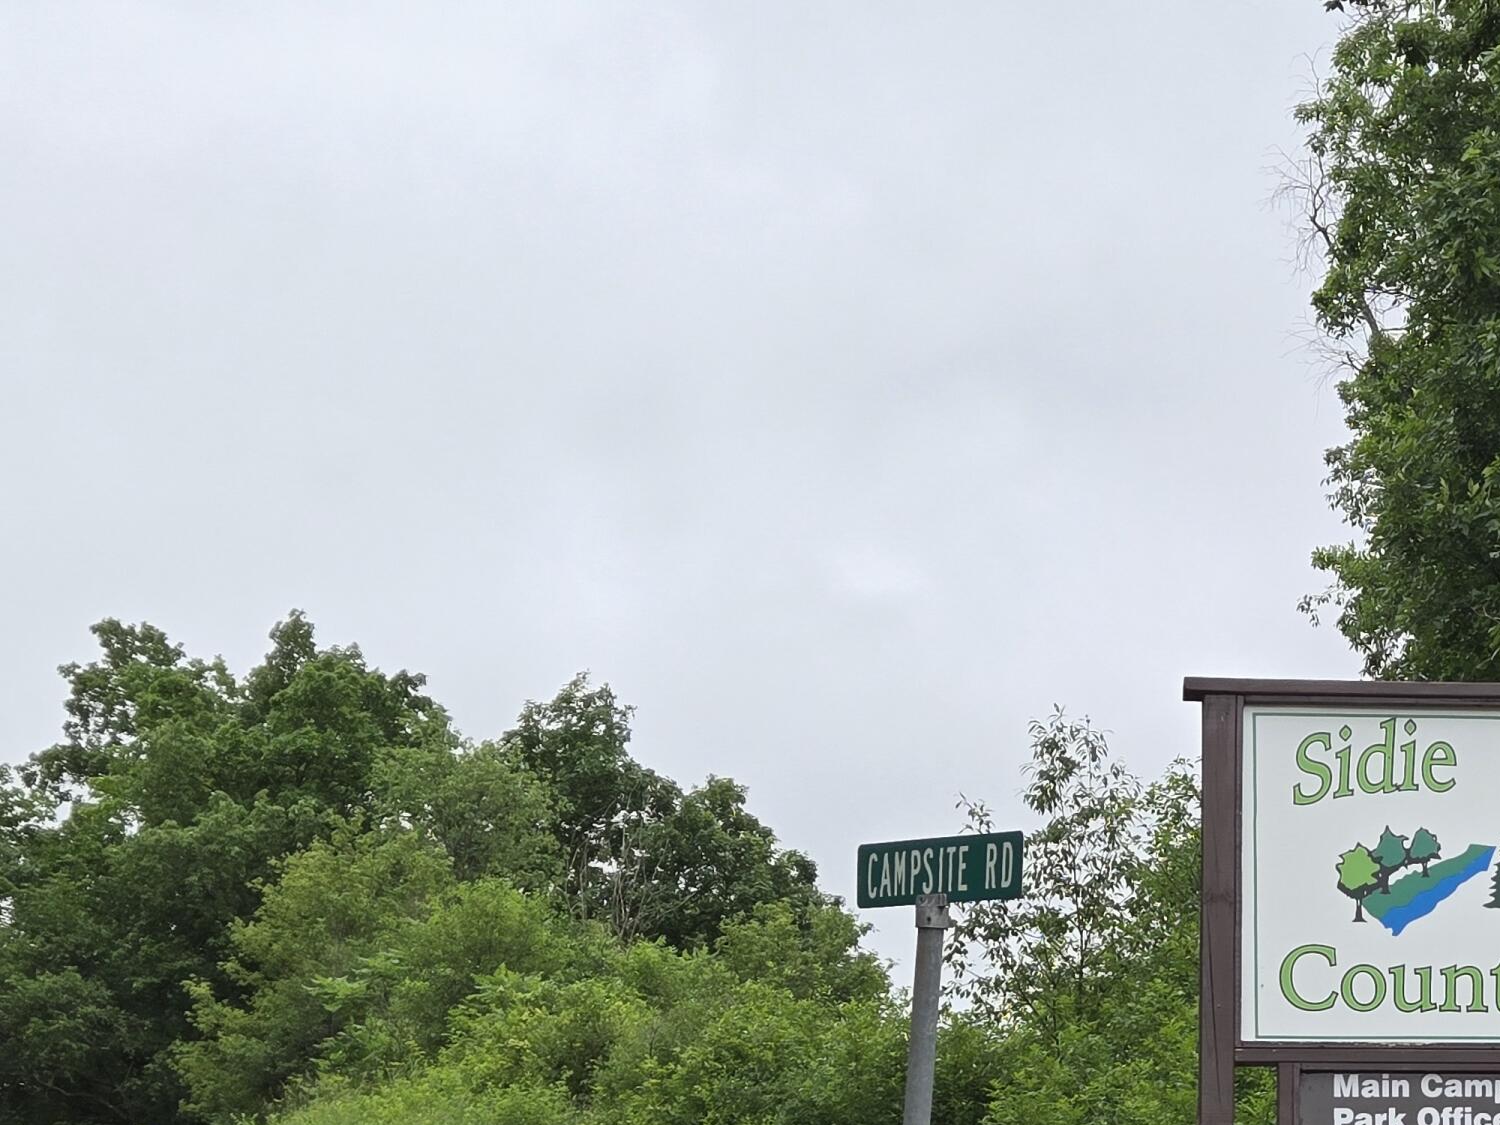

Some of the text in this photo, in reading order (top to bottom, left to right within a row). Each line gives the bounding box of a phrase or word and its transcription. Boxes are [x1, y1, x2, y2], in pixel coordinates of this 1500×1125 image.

[1292, 717, 1457, 806] Sidie
[867, 841, 1014, 899] CAMPSITE RD
[1333, 1073, 1410, 1098] Main
